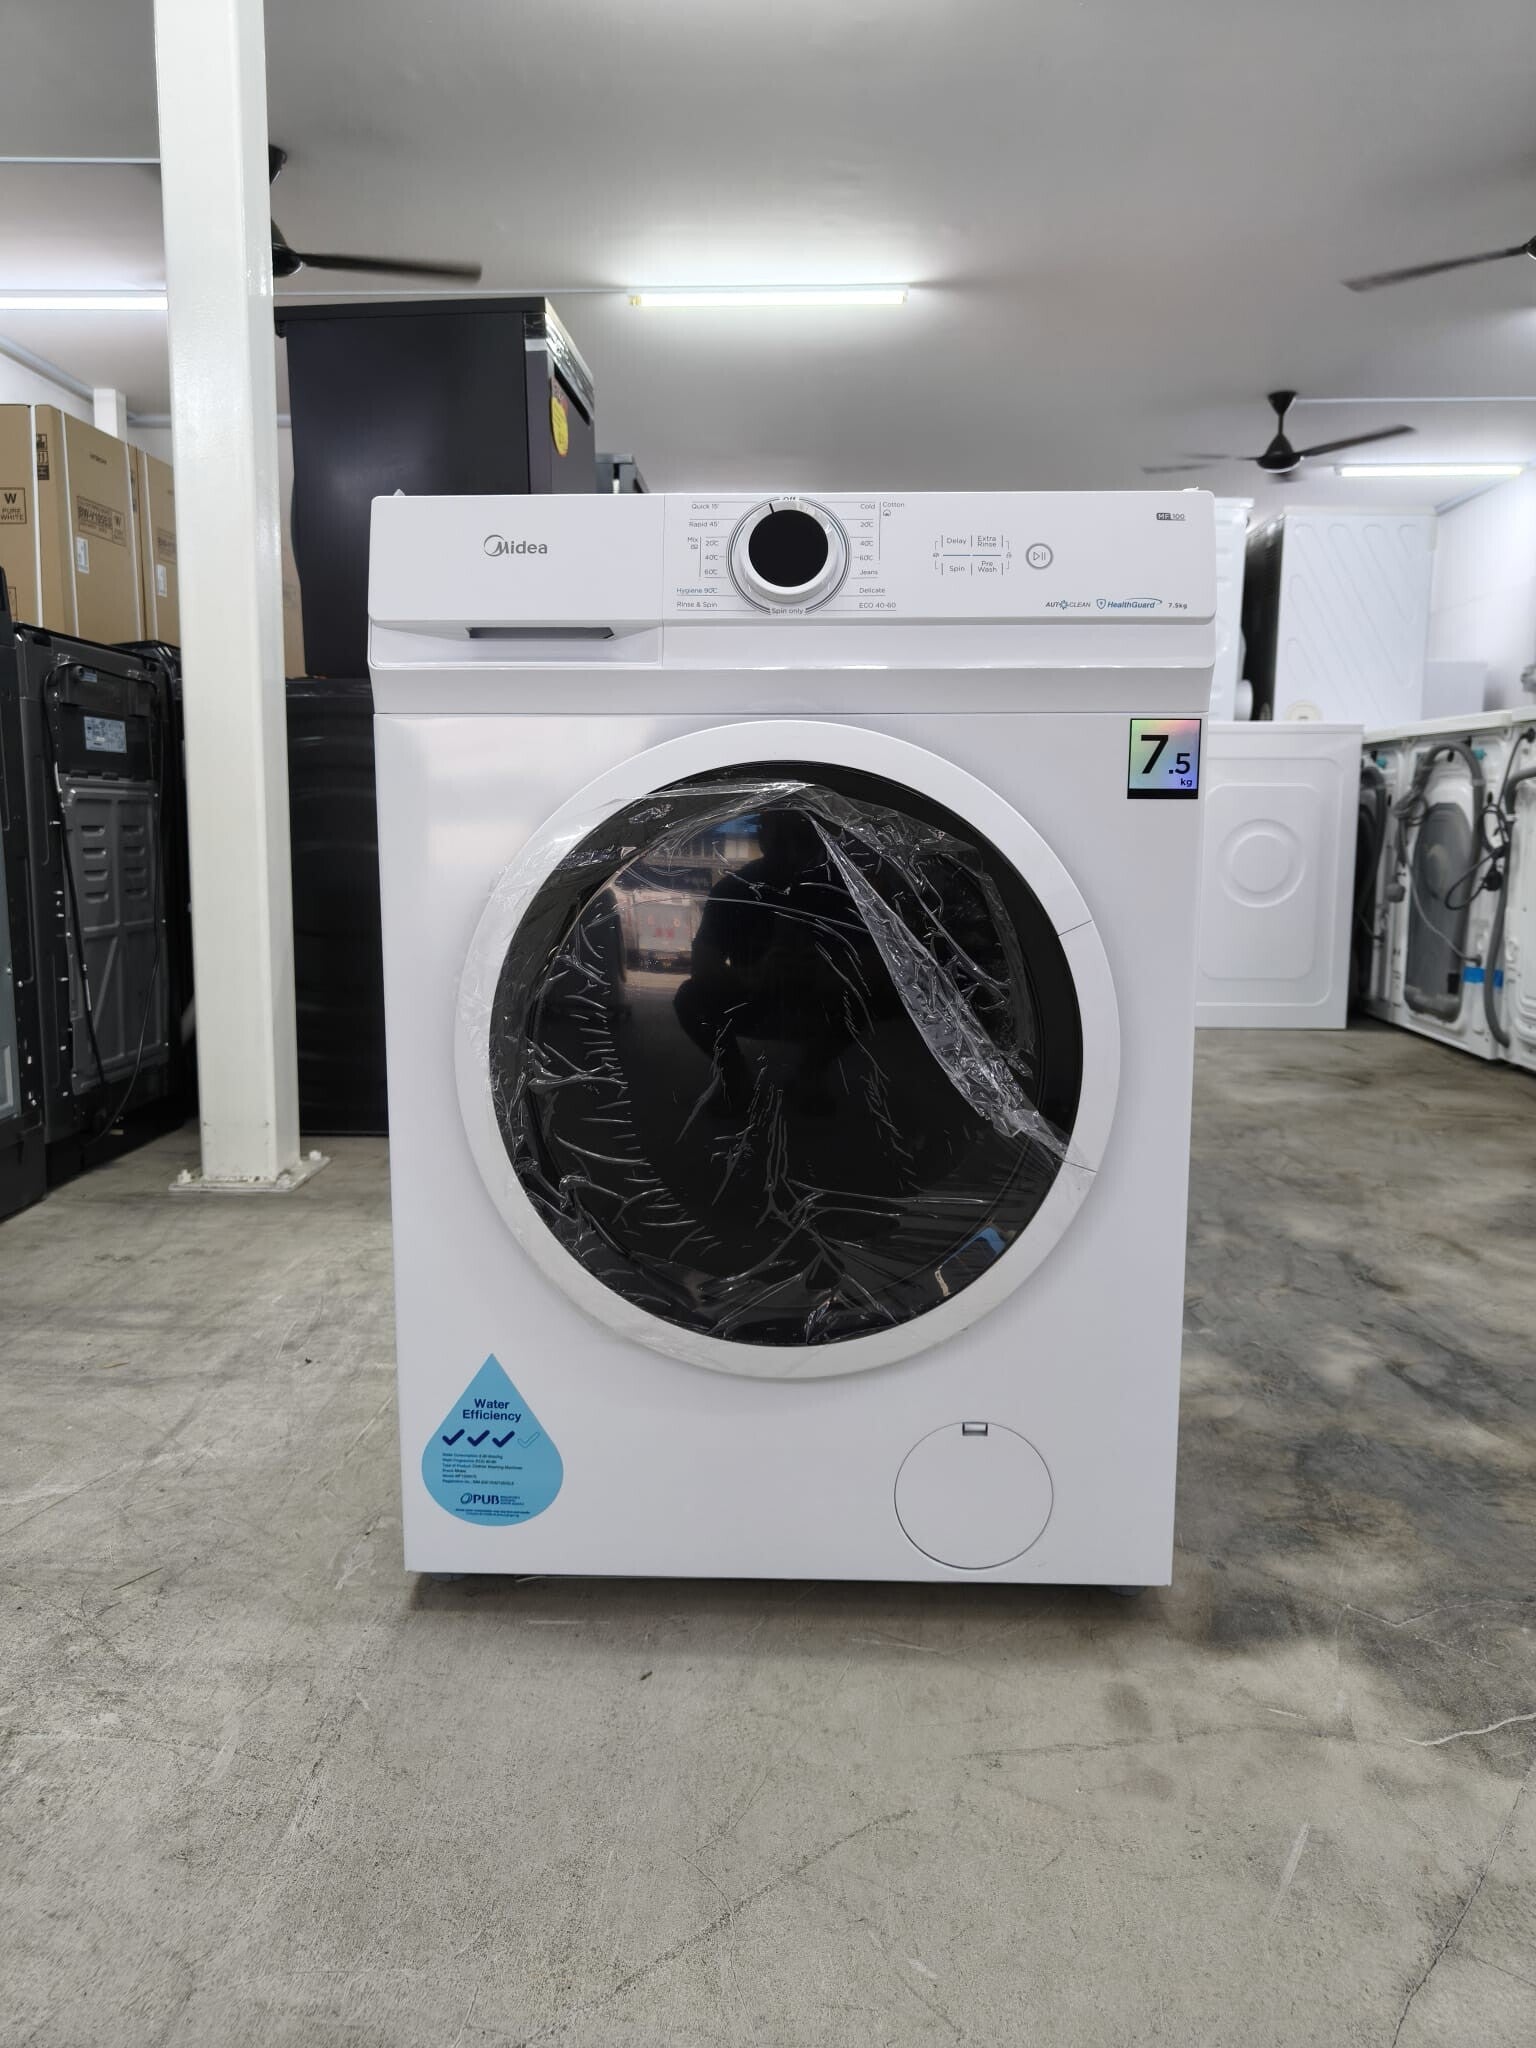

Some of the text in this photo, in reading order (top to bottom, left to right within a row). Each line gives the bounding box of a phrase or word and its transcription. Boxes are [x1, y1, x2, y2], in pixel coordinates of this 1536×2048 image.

[4, 492, 17, 505] W
[483, 534, 548, 557] Midea
[946, 537, 967, 545] Delay
[949, 565, 966, 573] Spin
[676, 587, 703, 595] Hygiene
[702, 601, 718, 609] Spin
[1107, 600, 1156, 610] HealthGuard
[771, 607, 804, 615] Spin only
[1140, 734, 1191, 775] 7.5
[1180, 778, 1193, 788] kg
[474, 1398, 510, 1409] Water
[462, 1409, 522, 1423] Efficiency
[473, 1494, 500, 1505] PUB
